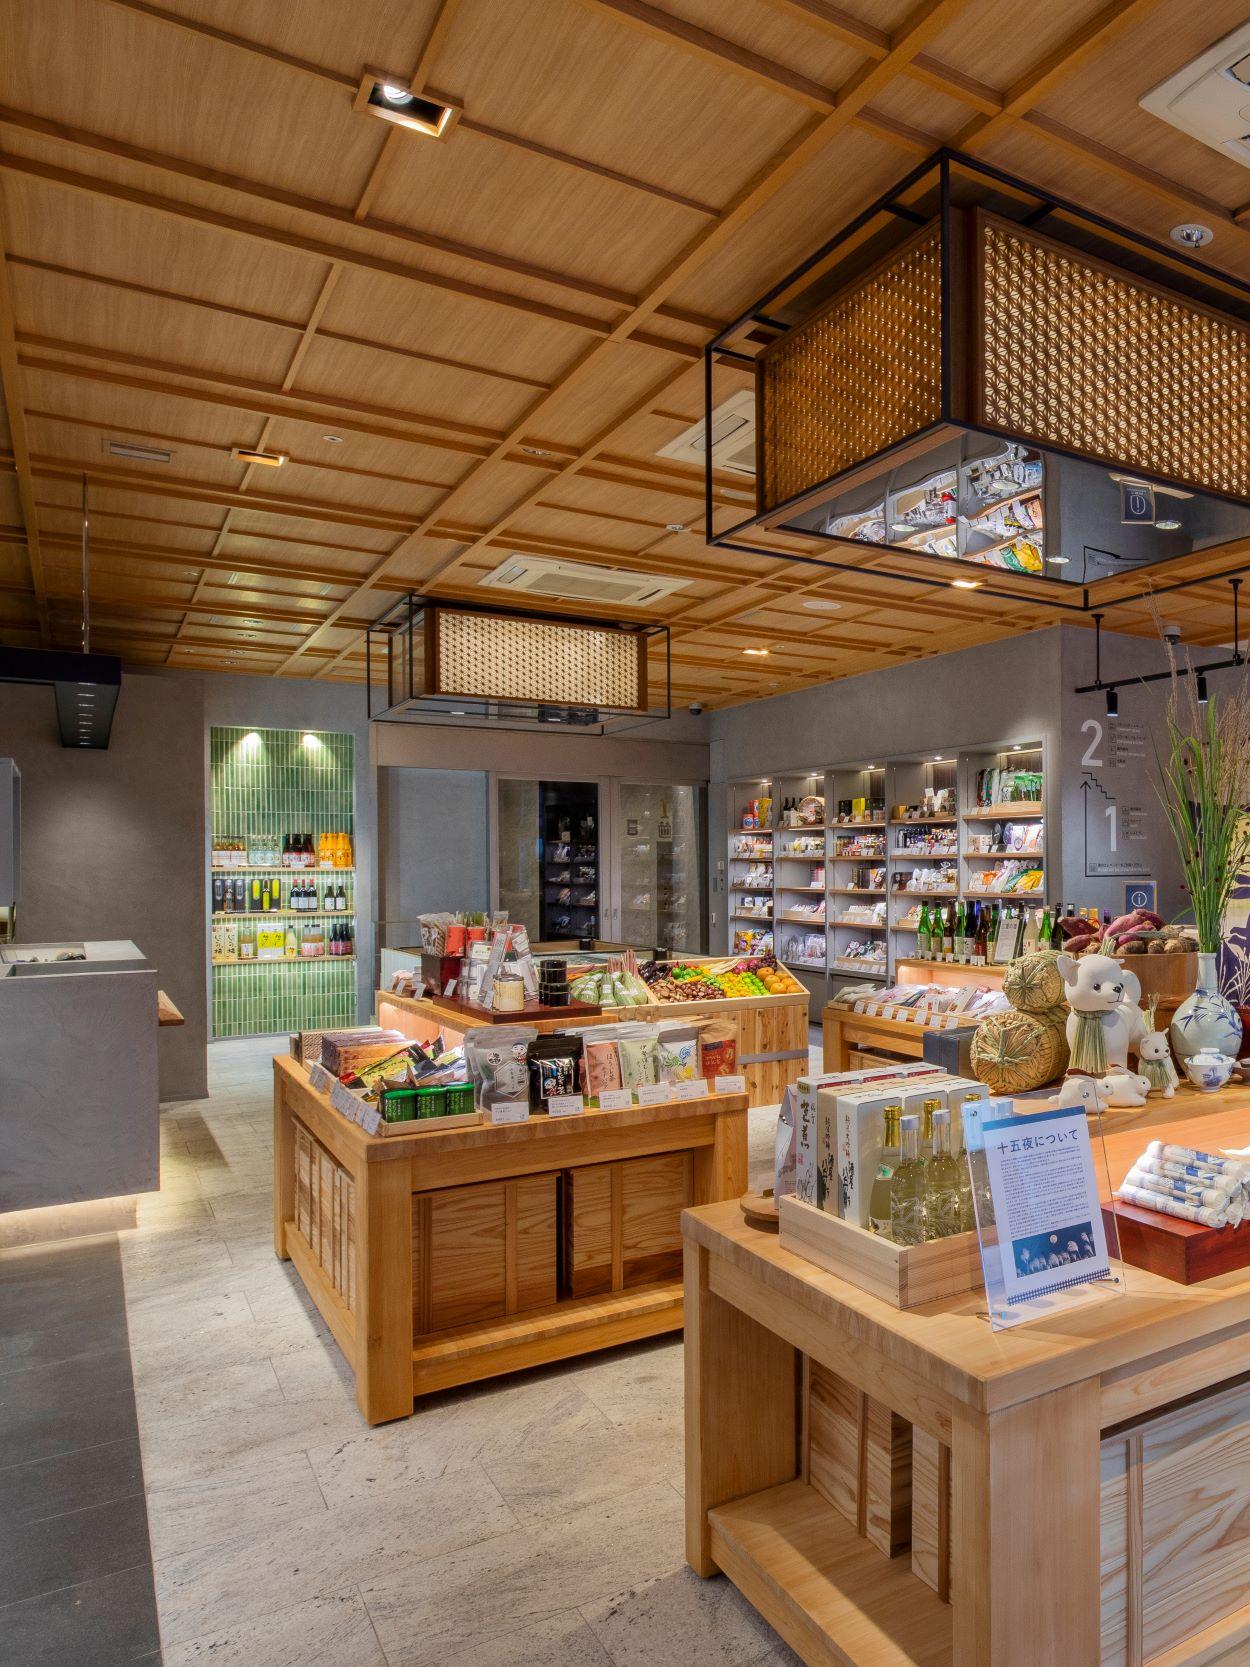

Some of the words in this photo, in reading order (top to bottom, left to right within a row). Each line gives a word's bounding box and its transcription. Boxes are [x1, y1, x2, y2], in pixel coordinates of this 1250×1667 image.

[1080, 719, 1103, 767] 2
[1105, 806, 1117, 852] 1
[996, 1128, 1080, 1156] 十五夜について
